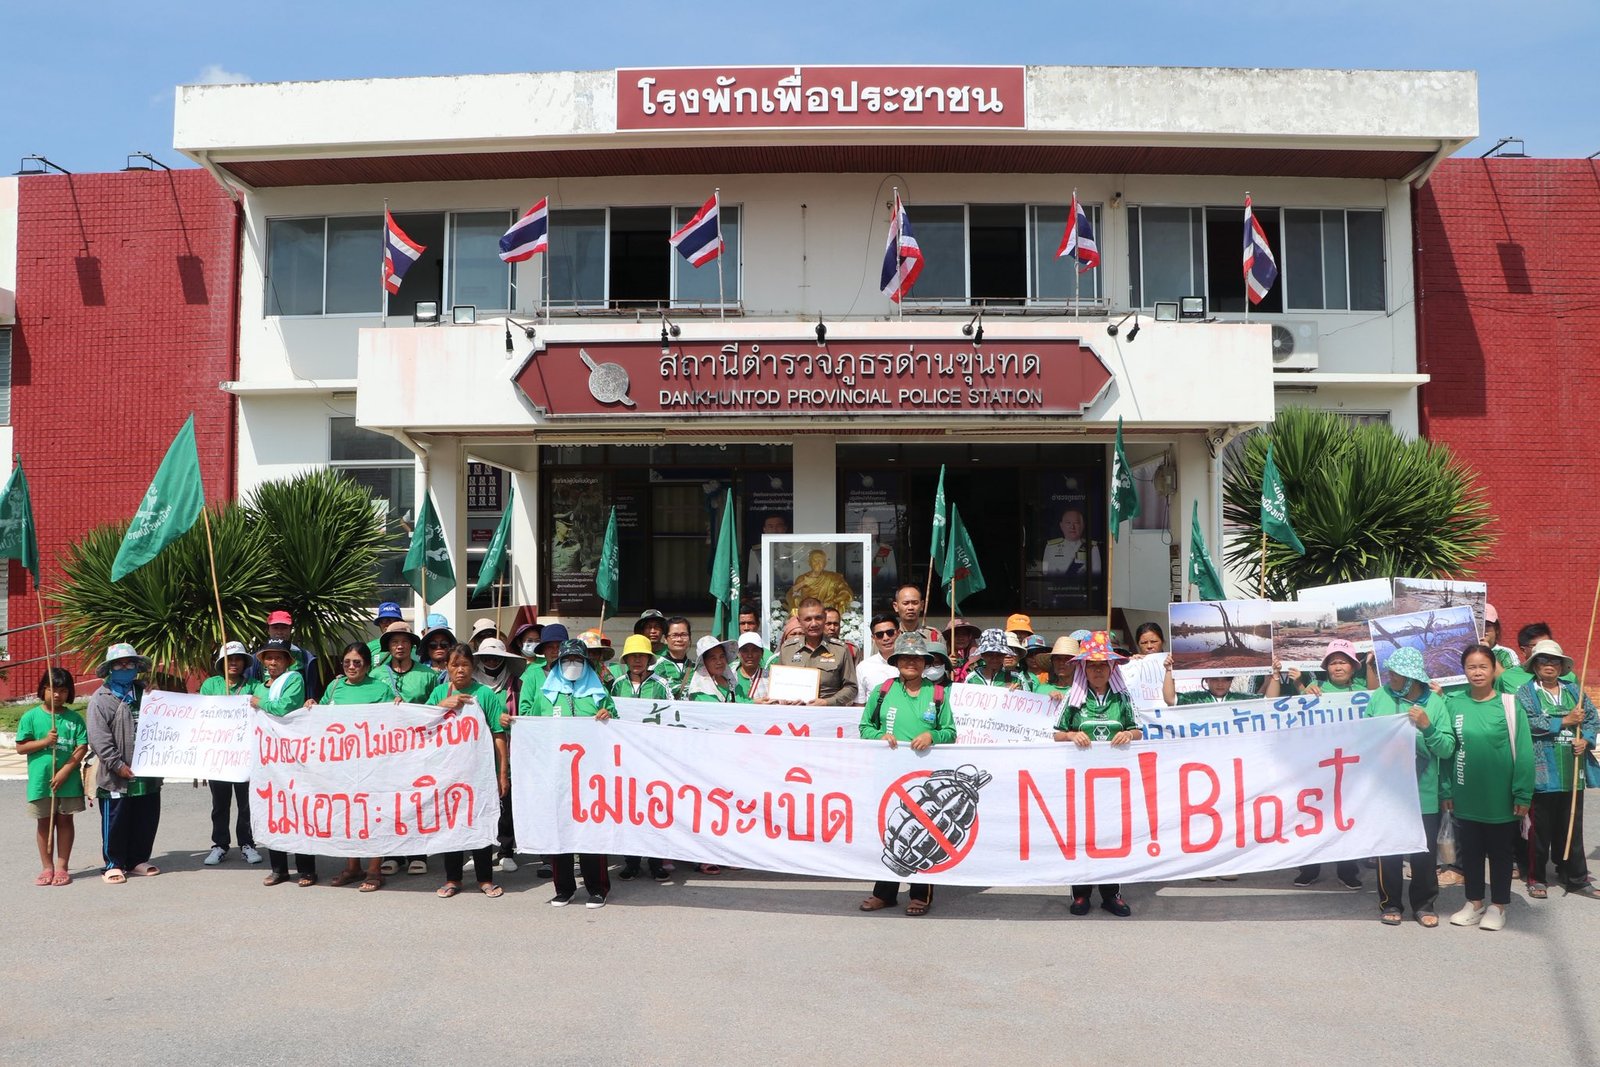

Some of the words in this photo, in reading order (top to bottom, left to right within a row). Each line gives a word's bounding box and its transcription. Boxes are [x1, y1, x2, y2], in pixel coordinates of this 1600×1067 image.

[637, 67, 1004, 116] โรงพักเพื่อประชาชน
[659, 344, 1041, 386] สถานีตำรวจภูธรด่านขุนทด
[659, 388, 780, 406] DANKHUNTOD
[787, 388, 891, 406] PROVINCIAL
[899, 388, 961, 405] POLICE
[968, 388, 1042, 405] STATION
[559, 743, 853, 844] ไม่เอาระเบิด
[1179, 748, 1361, 854] Blast
